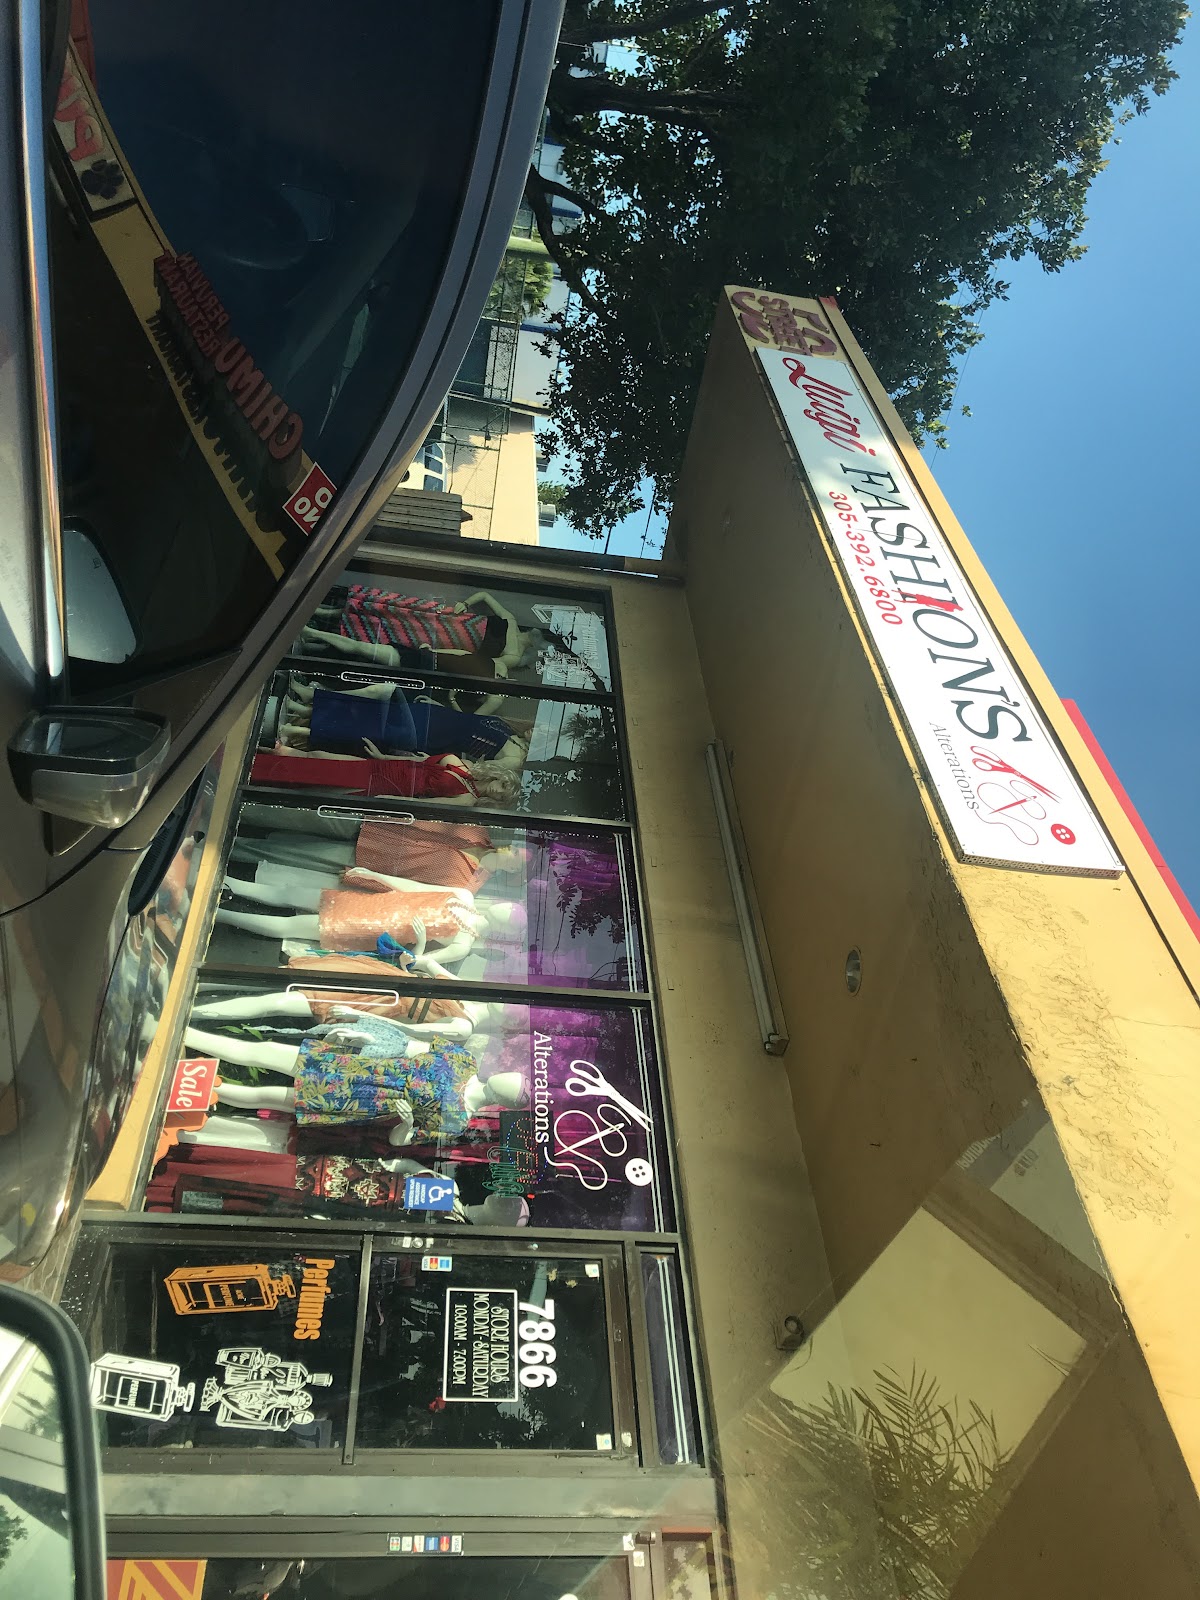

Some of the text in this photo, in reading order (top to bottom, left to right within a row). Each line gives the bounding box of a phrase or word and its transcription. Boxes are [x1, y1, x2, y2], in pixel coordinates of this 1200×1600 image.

[758, 296, 811, 356] STREET
[782, 357, 1033, 743] Luigi FASHION'S
[828, 491, 903, 625] 305-392.6800
[581, 626, 599, 660] Perfumes
[928, 722, 980, 810] Alterations
[176, 1062, 208, 1107] Sale
[533, 1030, 554, 1144] Alterations
[516, 1118, 539, 1184] OPEN
[220, 1284, 234, 1306] PERFUME
[293, 1258, 335, 1340] Perfumes
[453, 1304, 467, 1340] 10:00AM
[452, 1350, 467, 1385] 7:00PM
[490, 1306, 509, 1383] STORE HOURS
[518, 1299, 558, 1388] 7866
[127, 1379, 140, 1407] PERFUME
